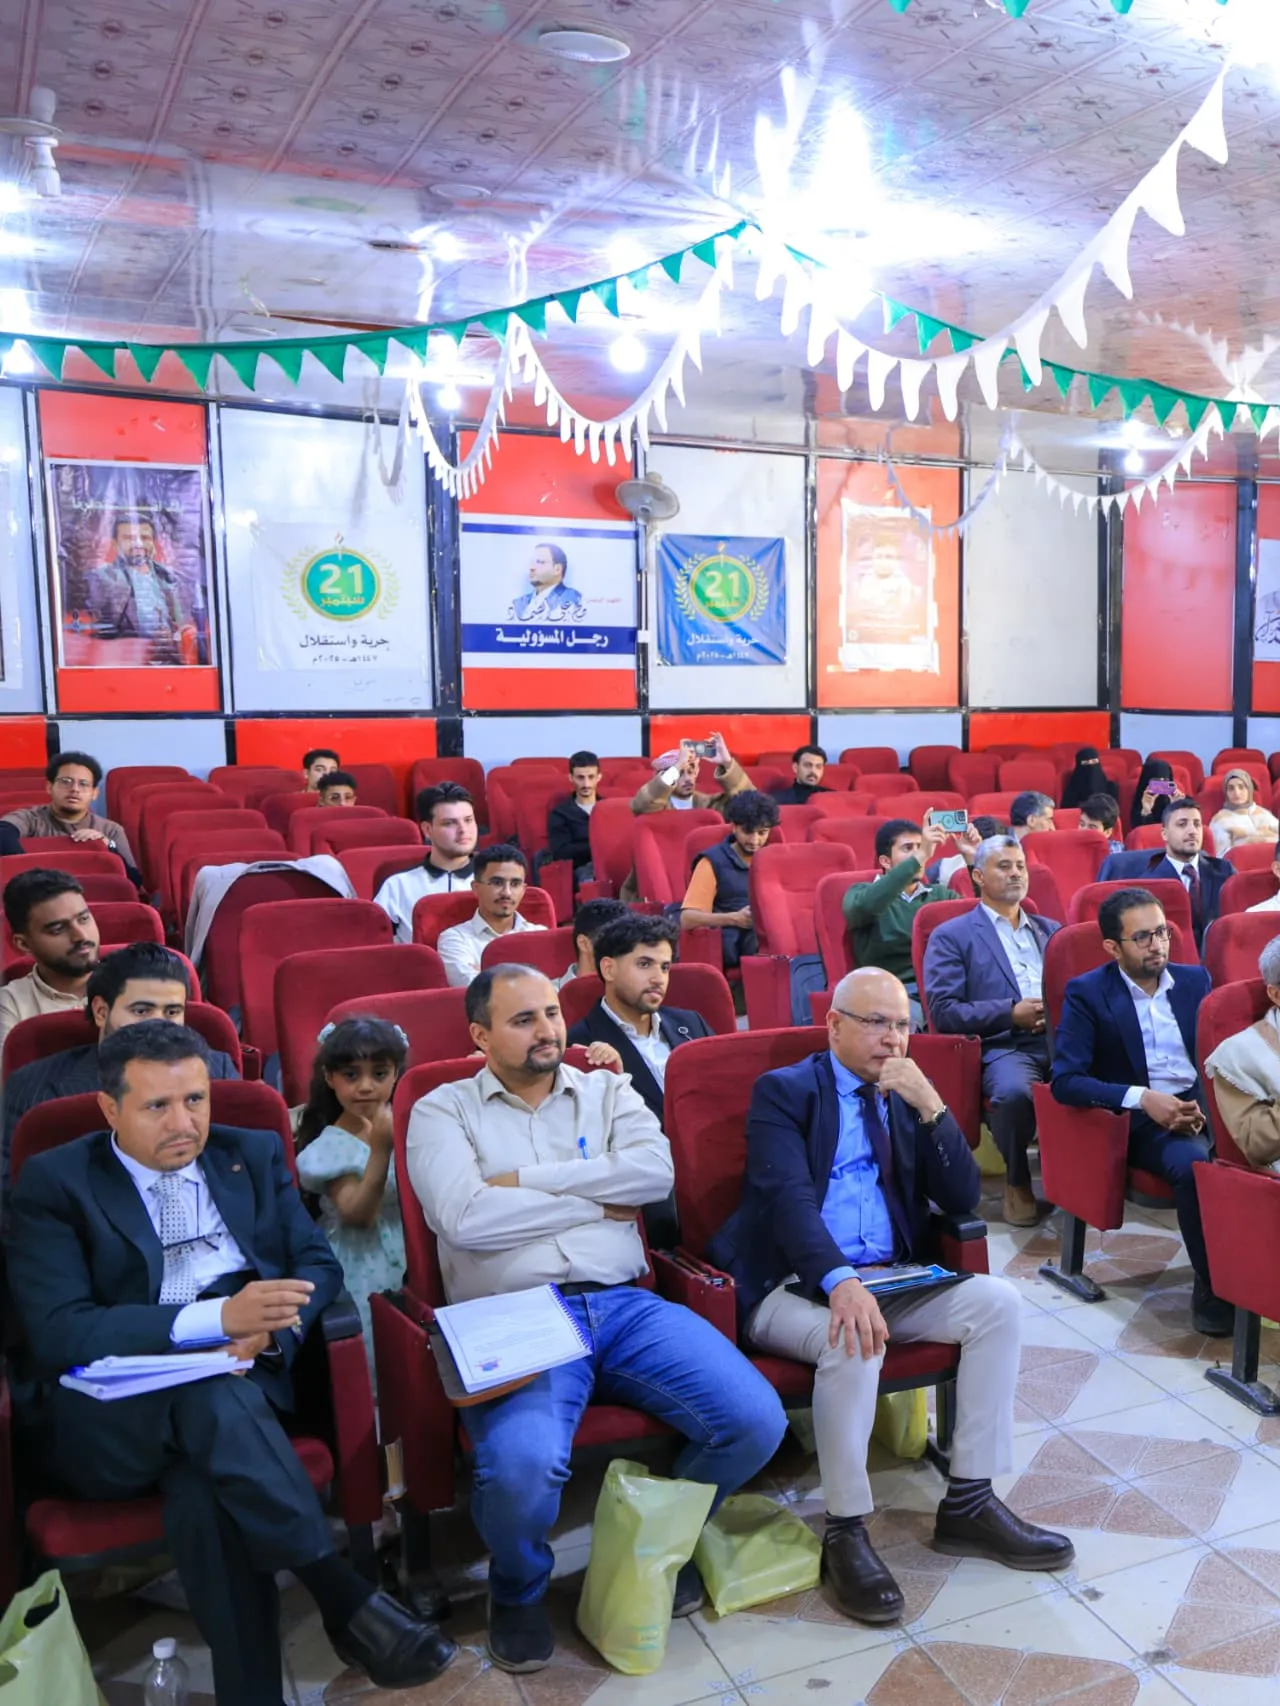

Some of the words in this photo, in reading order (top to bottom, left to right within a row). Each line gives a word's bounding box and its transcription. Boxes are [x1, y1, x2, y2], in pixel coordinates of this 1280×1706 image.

[319, 563, 364, 594] 21
[704, 570, 741, 598] 21
[299, 634, 358, 649] واستقلال
[495, 627, 564, 647] المسؤولية
[565, 628, 609, 648] رجل
